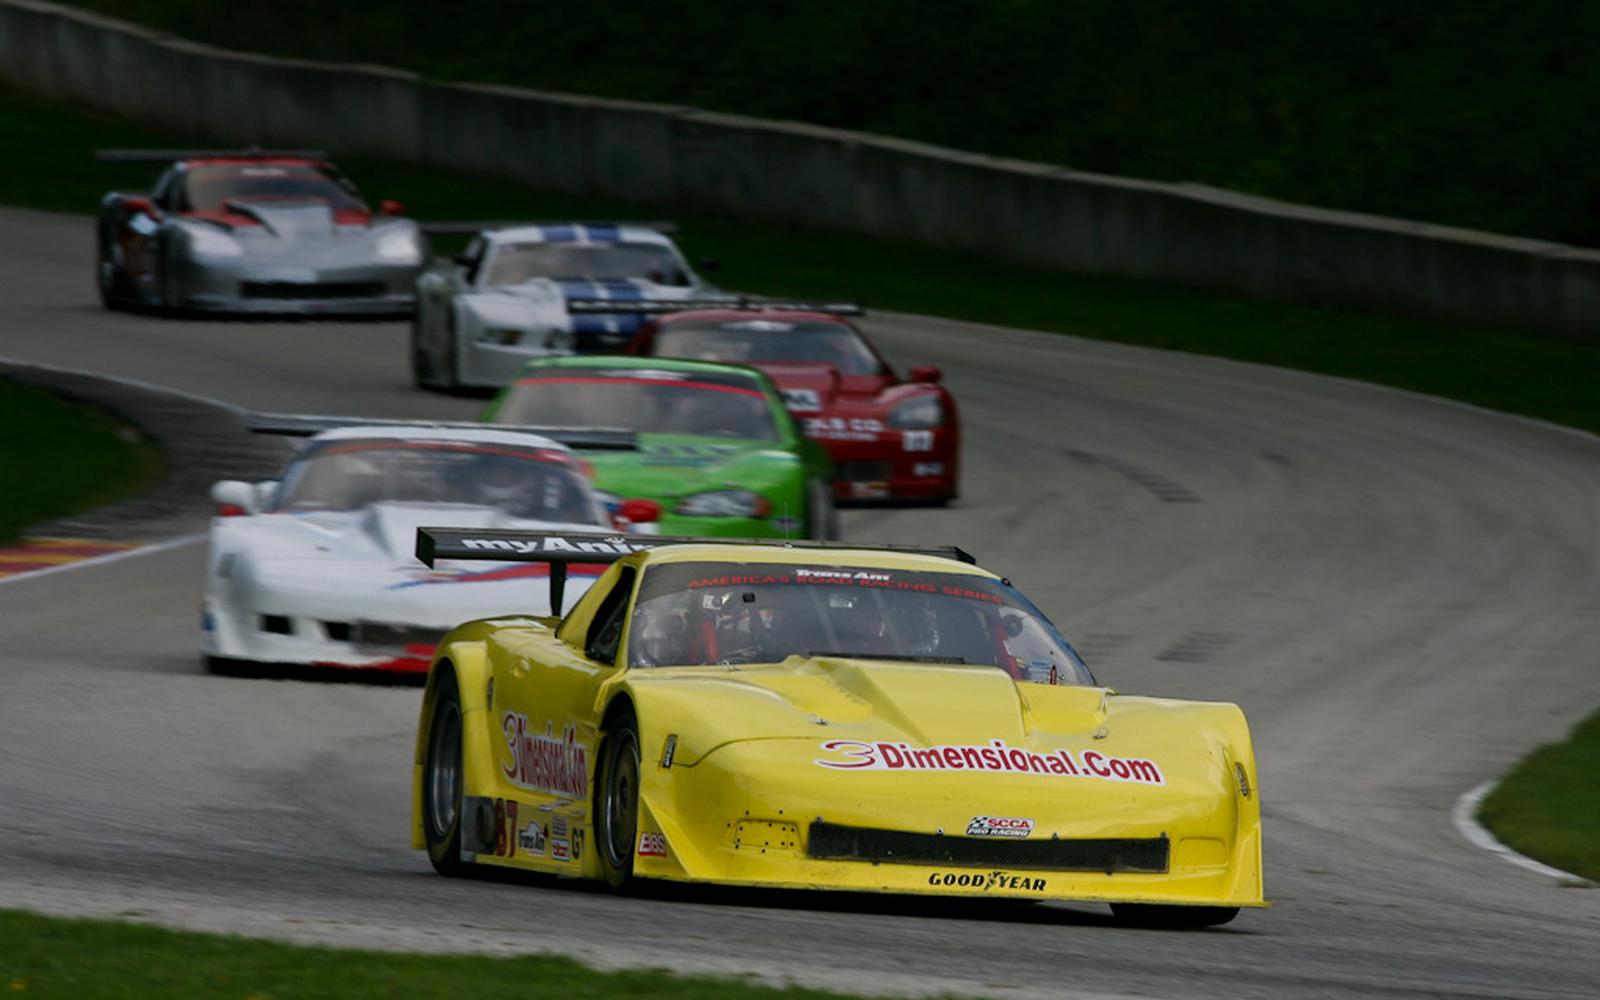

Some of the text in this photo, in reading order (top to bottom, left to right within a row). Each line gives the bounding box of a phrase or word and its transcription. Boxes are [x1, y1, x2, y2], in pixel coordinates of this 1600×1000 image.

[853, 572, 890, 581] Am
[796, 576, 852, 586] ROAD
[859, 579, 936, 593] RACING
[942, 586, 1002, 605] SERIES
[988, 818, 1031, 829] SCCA
[967, 828, 1028, 838] PRO RACING
